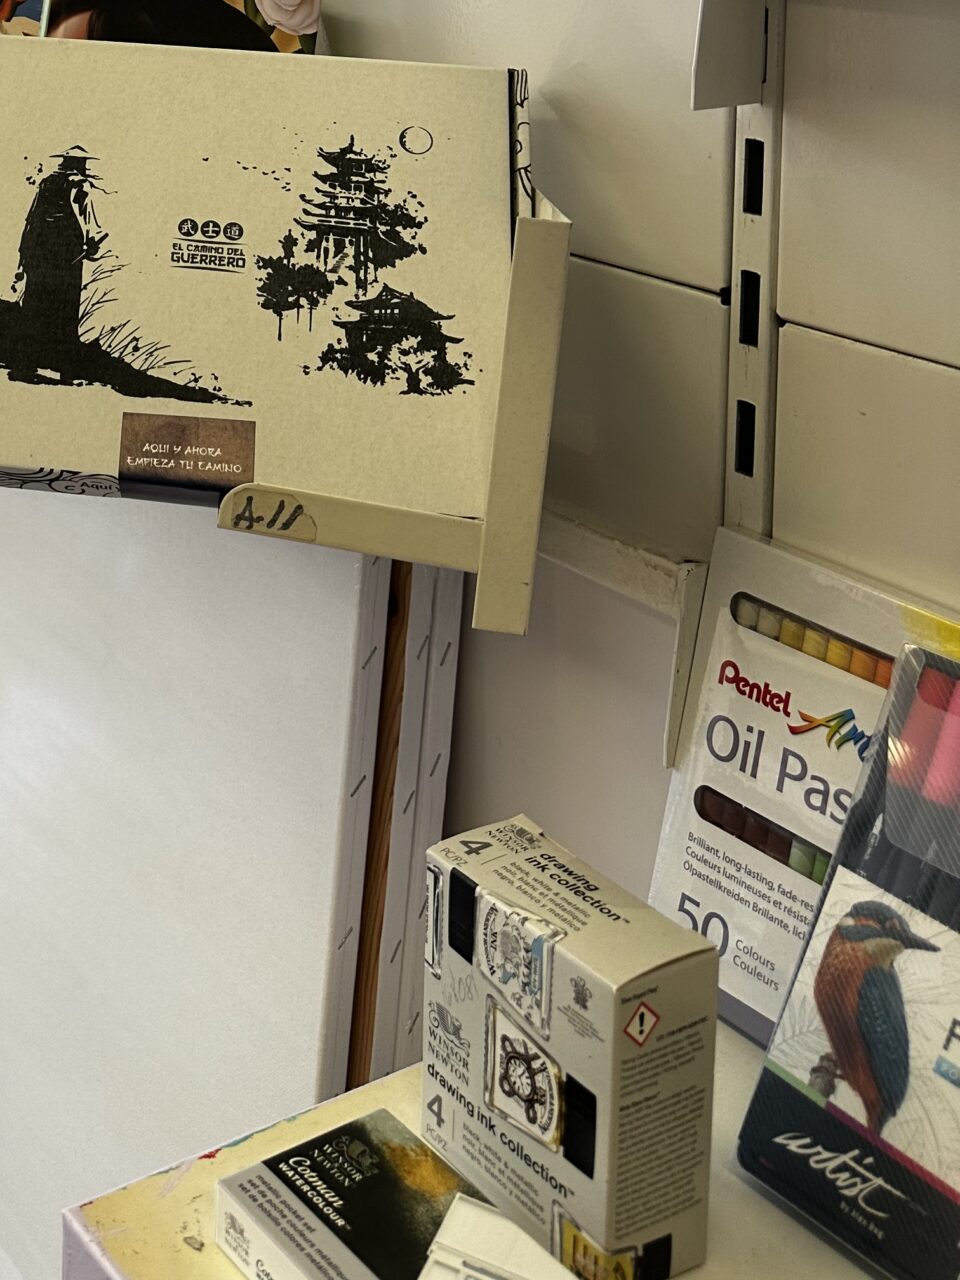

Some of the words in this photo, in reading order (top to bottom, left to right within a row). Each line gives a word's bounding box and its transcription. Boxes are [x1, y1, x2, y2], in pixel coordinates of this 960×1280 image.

[179, 219, 242, 240] 武士道
[171, 252, 246, 268] GUERRERO
[172, 243, 183, 251] EL
[186, 244, 224, 254] CAMINO
[227, 247, 245, 256] DEL
[127, 456, 175, 469] EMPIEZA
[179, 460, 194, 470] TU
[198, 461, 242, 474] CAMINO
[184, 444, 222, 457] AHORA
[718, 660, 791, 717] Pentel
[706, 715, 765, 779] Oil
[440, 847, 469, 868] PC/PZ
[459, 840, 494, 856] 4
[486, 830, 522, 855] NEWTON
[496, 827, 530, 852] WINSOR
[525, 856, 551, 873] ink
[540, 852, 599, 892] drawing
[685, 846, 721, 874] Couleurs
[722, 865, 771, 904] lumineuses
[773, 899, 783, 911] et
[688, 832, 721, 860] Brilliant,
[722, 851, 776, 891] long-lasting,
[683, 859, 751, 908] Ölpastellkreiden
[752, 902, 791, 933] Brillante,
[678, 892, 729, 958] 50
[733, 954, 780, 991] Couleurs
[736, 939, 776, 971] Colours
[428, 1026, 470, 1072] WINSOR
[428, 1041, 470, 1086] NEWTON
[427, 1062, 474, 1117] drawing
[477, 1109, 496, 1136] ink
[427, 1094, 445, 1128] 4
[289, 1156, 345, 1208] Cotman
[312, 1149, 352, 1188] NEWTON
[323, 1144, 363, 1183] WINSOR
[256, 1174, 282, 1200] metallic
[280, 1199, 305, 1222] pocket
[266, 1199, 287, 1220] poche
[287, 1218, 316, 1249] couleurs
[280, 1226, 307, 1253] colores
